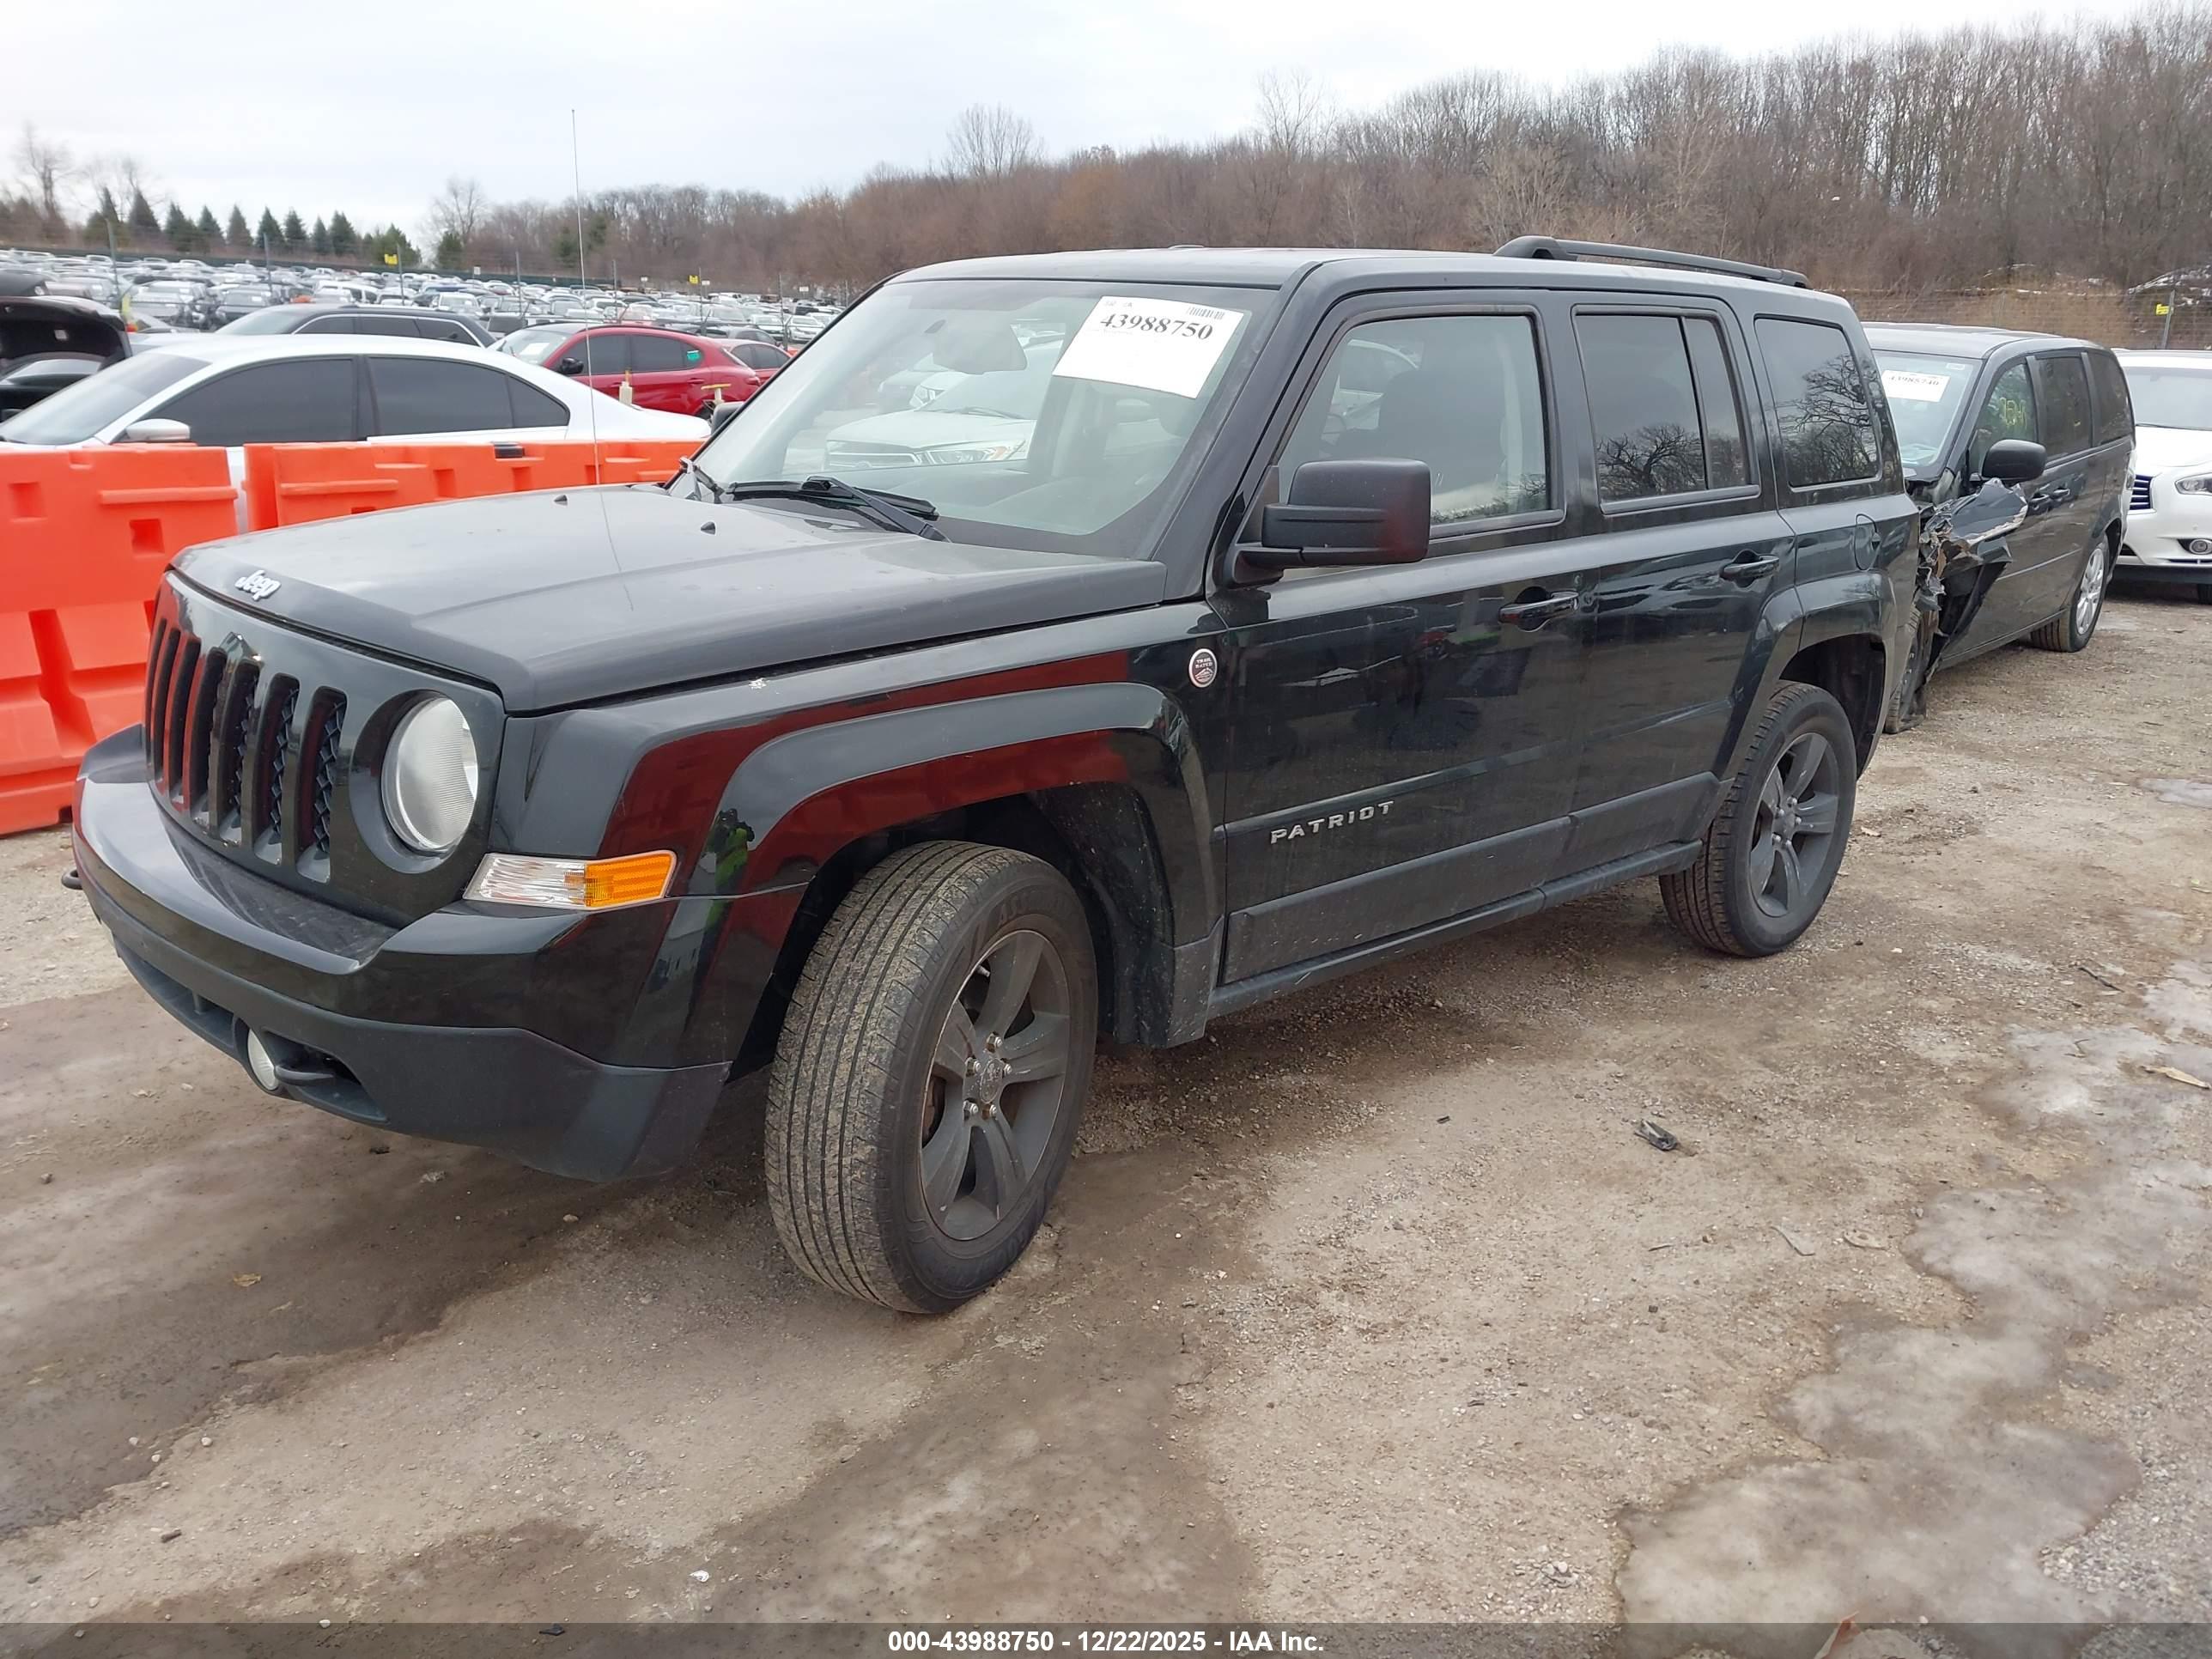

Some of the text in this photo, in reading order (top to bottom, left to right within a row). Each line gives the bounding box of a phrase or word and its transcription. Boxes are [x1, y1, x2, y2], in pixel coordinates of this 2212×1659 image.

[1100, 313, 1212, 340] 43988750
[234, 569, 281, 601] Jeep
[1270, 800, 1395, 845] PATRIOT
